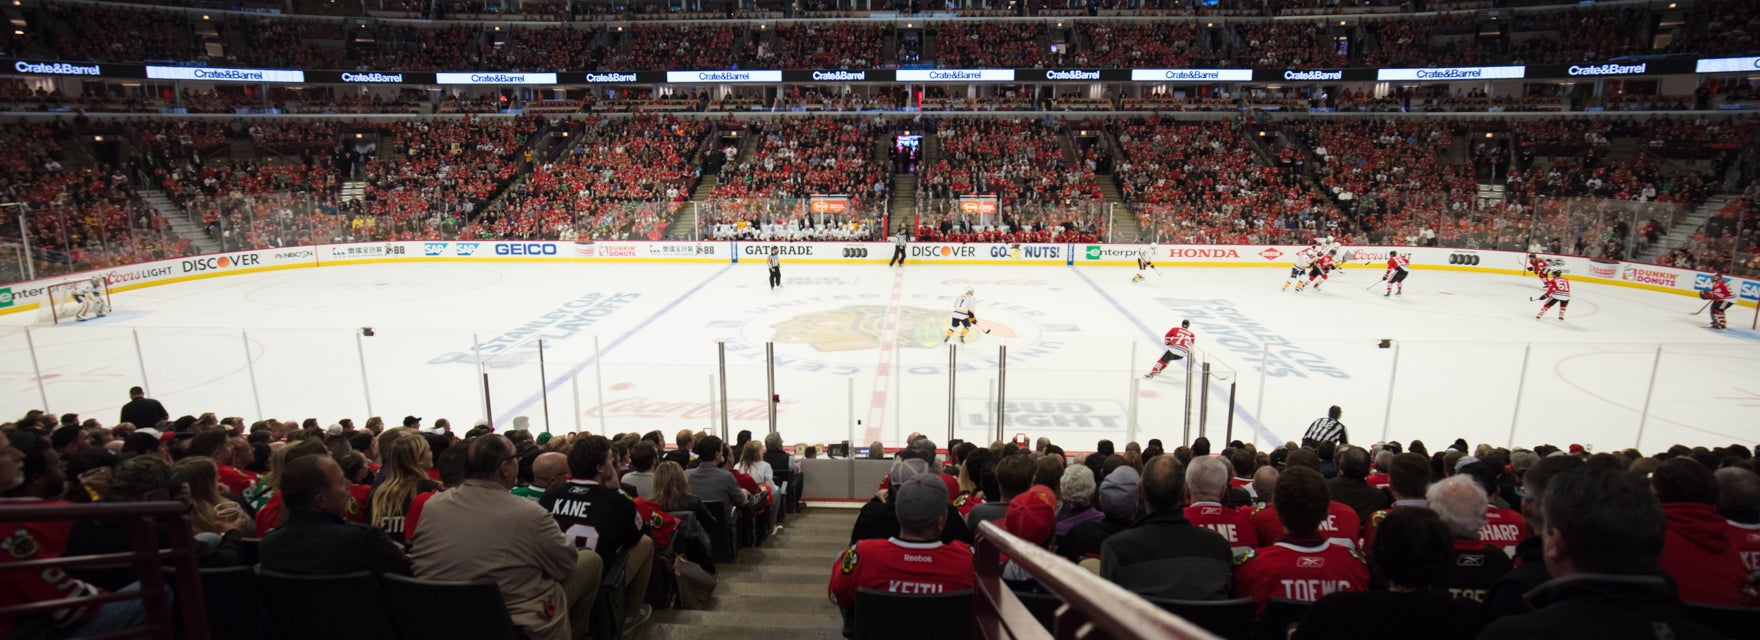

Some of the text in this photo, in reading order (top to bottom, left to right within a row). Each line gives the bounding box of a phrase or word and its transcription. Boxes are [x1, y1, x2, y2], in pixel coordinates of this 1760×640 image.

[15, 60, 100, 77] Crate&Barrel
[194, 69, 263, 80] Crate&Barrel
[1416, 68, 1481, 80] Crate&Barrel
[1568, 64, 1646, 76] Crate&Barrel
[341, 73, 402, 83] Crate&Barrel
[470, 74, 525, 83] Crate&Barrel
[586, 73, 636, 82] Crate&Barrel
[698, 72, 750, 81] Crate&Barrel
[812, 71, 864, 81] Crate&Barrel
[928, 71, 981, 80] Crate&Barrel
[1046, 70, 1099, 80] Crate&Barrel
[1165, 70, 1218, 80] Crate&Barrel
[1284, 71, 1342, 80] Crate&Barrel
[425, 243, 443, 255] SAP
[457, 243, 474, 255] SAP
[495, 243, 557, 255] GEICO
[745, 245, 813, 256] GATRADE
[912, 245, 976, 257] DISCOVER
[990, 246, 1007, 258] GO
[1025, 246, 1060, 258] NUTS!
[1091, 249, 1141, 258] enterpri
[1169, 249, 1240, 258] HONDA
[1352, 249, 1384, 261] Coors
[182, 253, 259, 273] DISCOVER
[106, 266, 172, 285] Coors LIGHT
[1637, 274, 1676, 286] DONUTS
[1695, 276, 1713, 291] SA
[1740, 283, 1760, 298] SA
[968, 413, 1120, 428] LIGHT
[552, 498, 592, 518] KANE
[1199, 523, 1239, 543] ANE
[1477, 522, 1519, 542] SHARP
[904, 554, 933, 565] Reebok
